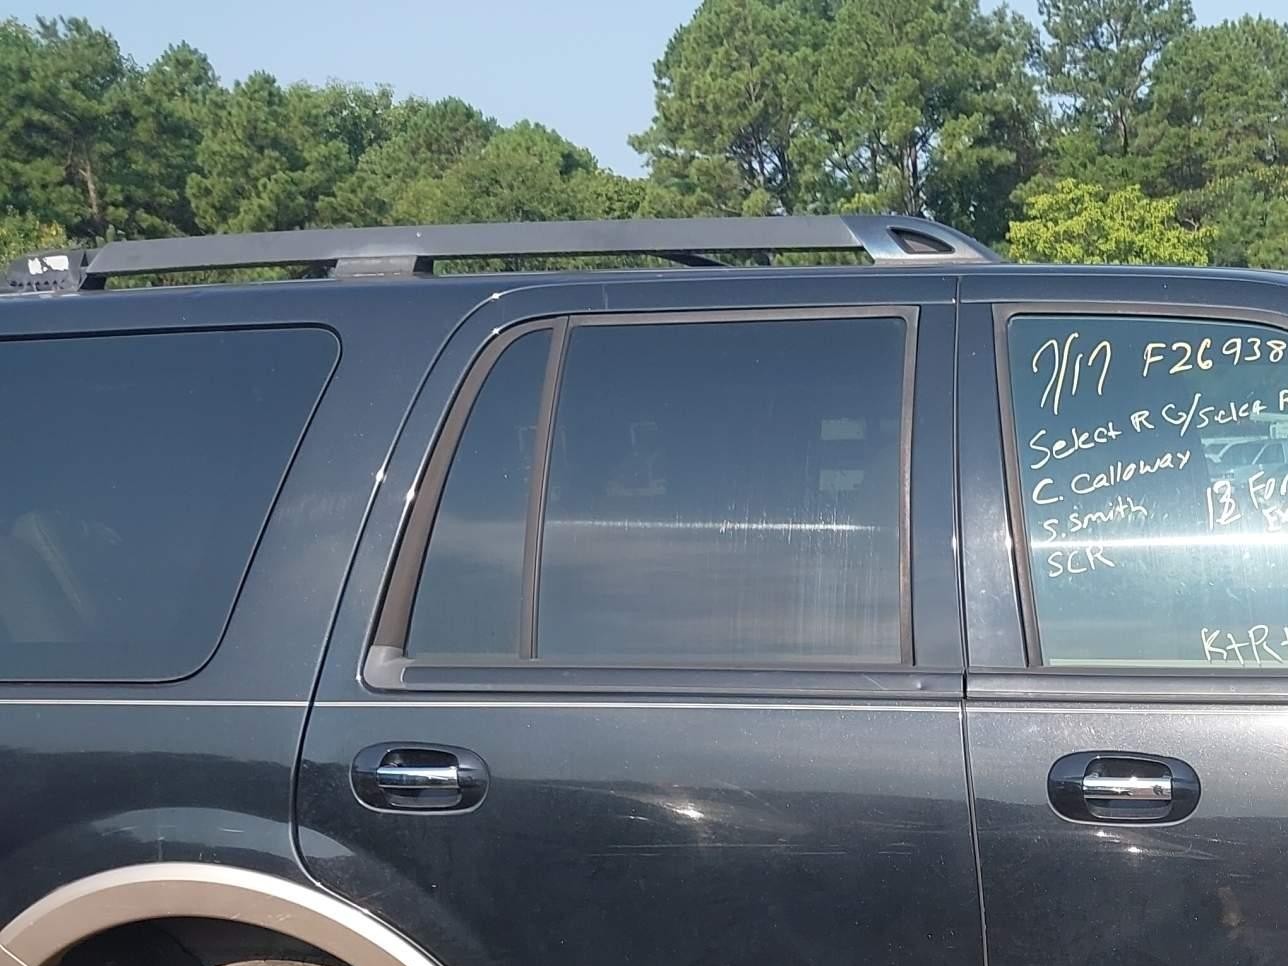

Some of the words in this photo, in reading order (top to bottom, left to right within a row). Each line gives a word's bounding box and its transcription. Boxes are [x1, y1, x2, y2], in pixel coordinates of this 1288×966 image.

[1032, 332, 1112, 415] 7/17
[1030, 422, 1123, 469] Select
[1131, 410, 1154, 432] R
[1071, 450, 1190, 494] Calloway
[1048, 544, 1115, 577] SCR
